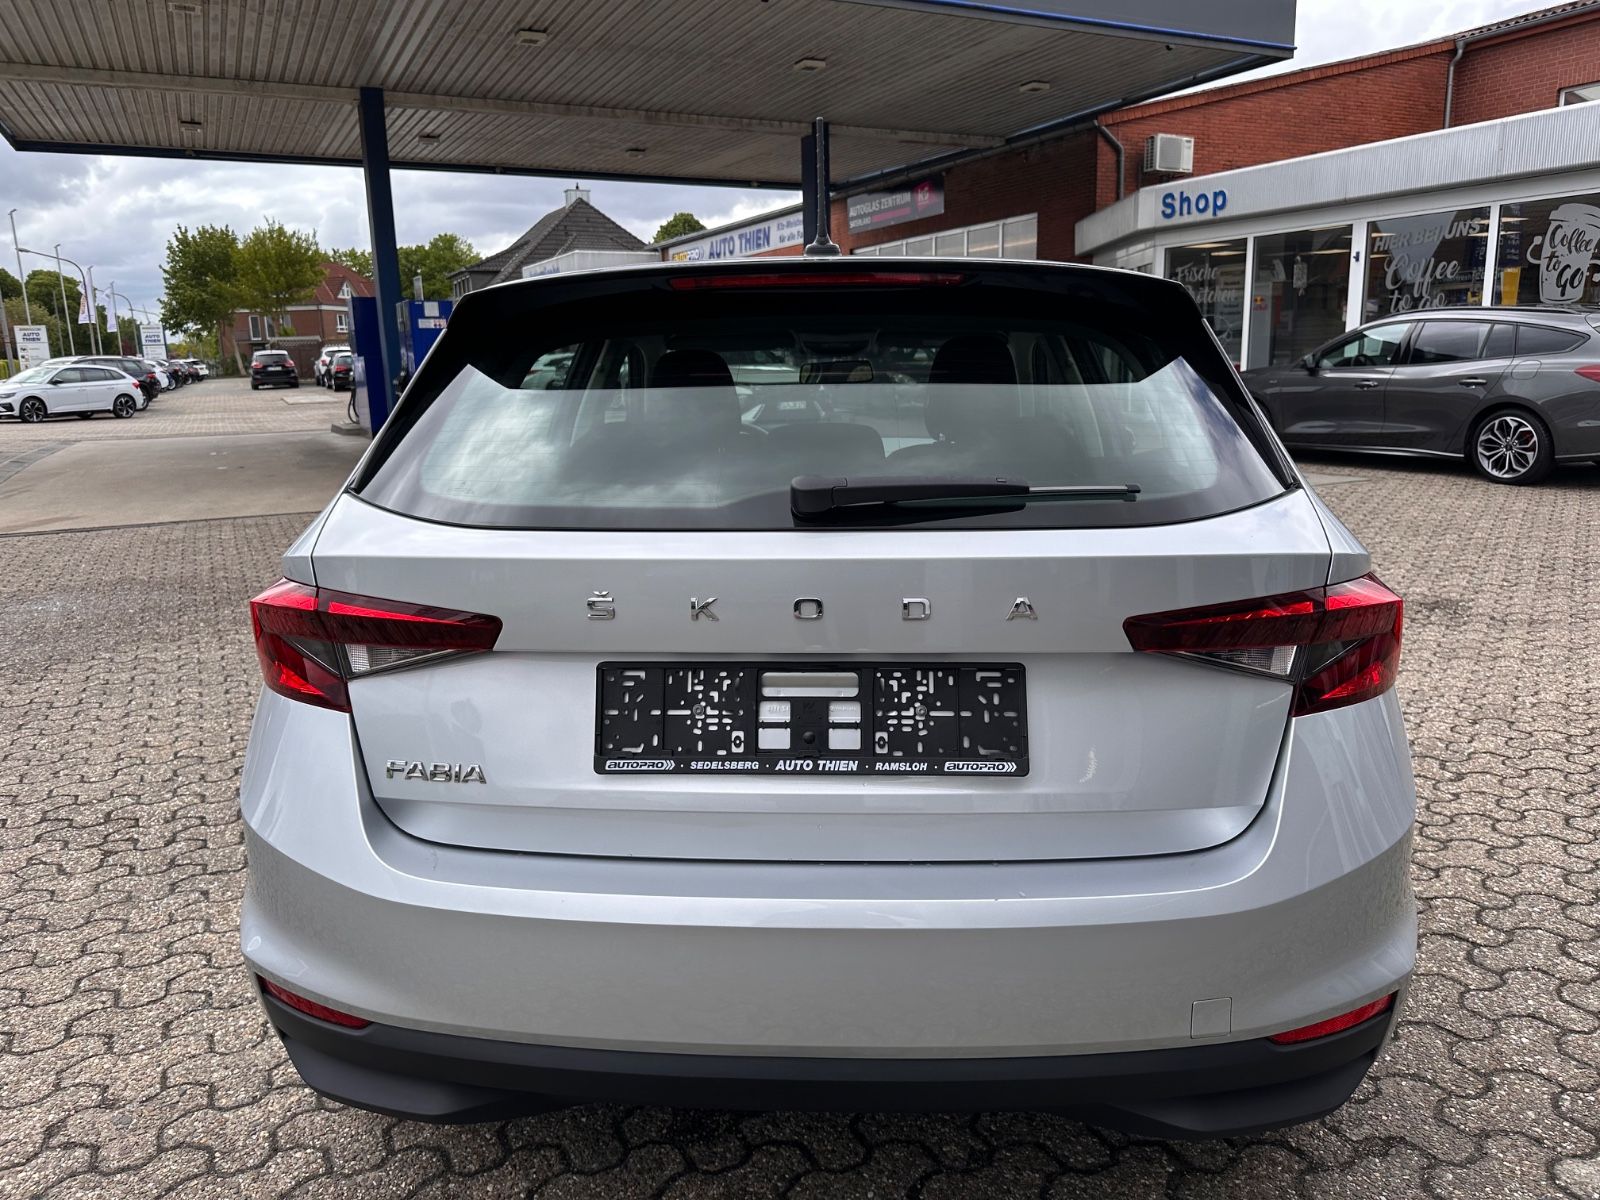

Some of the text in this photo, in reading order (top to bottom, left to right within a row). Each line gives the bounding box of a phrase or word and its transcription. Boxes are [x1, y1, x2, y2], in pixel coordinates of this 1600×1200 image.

[849, 192, 911, 217] AUTOGLAS ZENTRUM
[1161, 190, 1227, 219] Shop
[709, 226, 771, 259] AUTO THIEN
[1374, 218, 1481, 252] HIER BEI UNS
[1550, 224, 1593, 252] Coffee
[1174, 262, 1218, 282] Frische
[1384, 253, 1460, 298] Coffee
[1544, 254, 1562, 272] to
[1389, 290, 1412, 313] to
[586, 591, 1038, 622] ŠKODA
[386, 759, 487, 784] FABIA
[690, 761, 760, 770] SEDELSBERG
[775, 760, 813, 771] AUTO
[817, 760, 859, 771] THIEN
[875, 762, 928, 771] RAMSLOH
